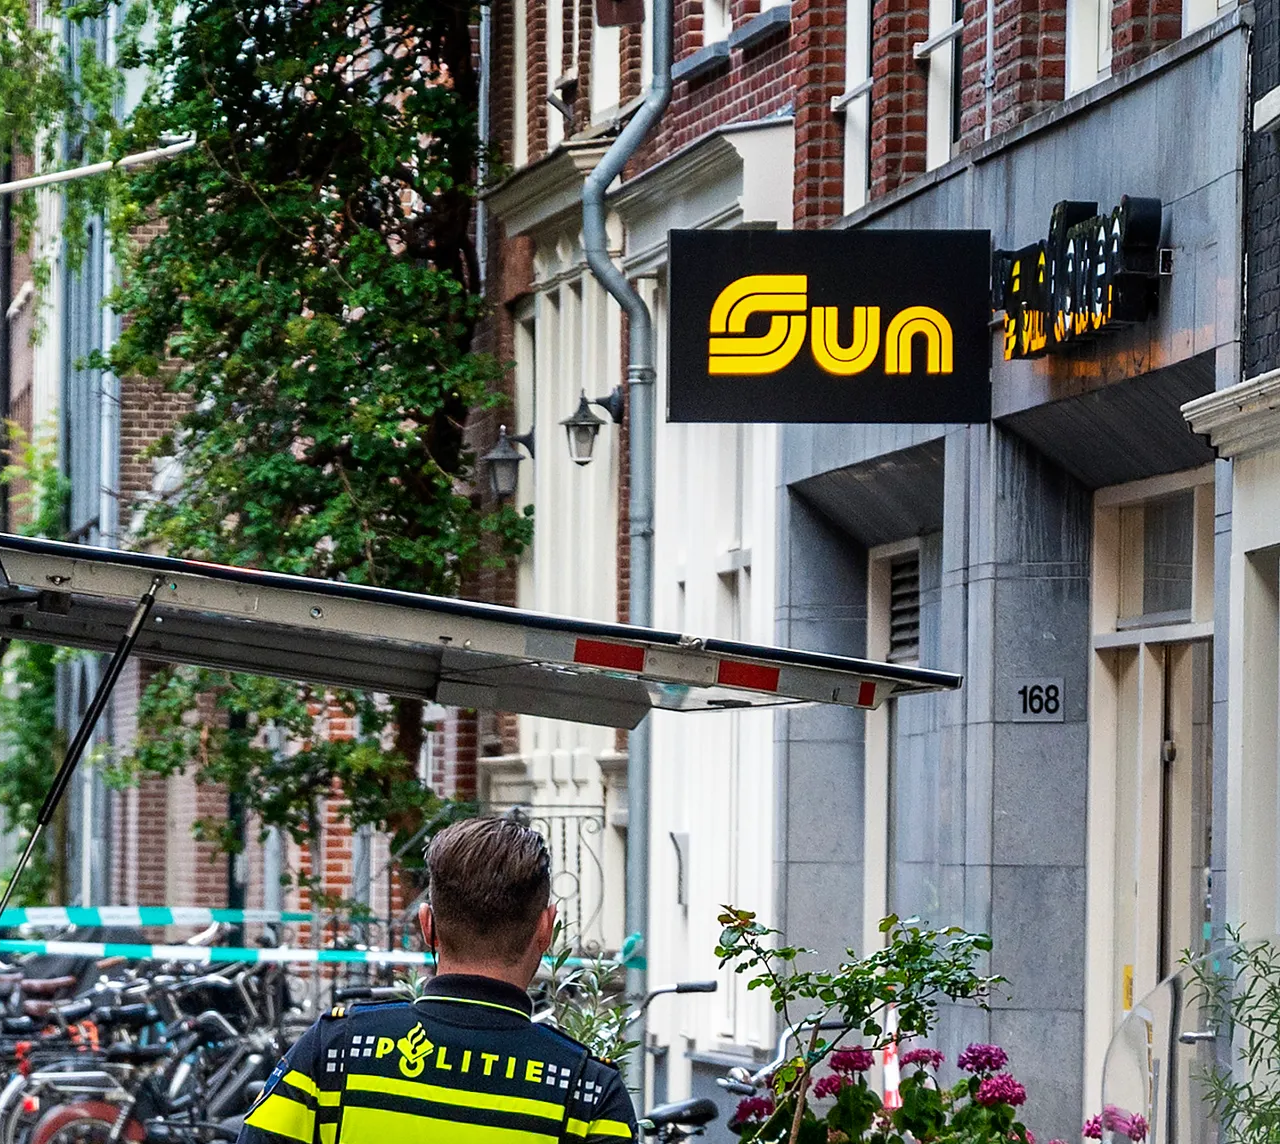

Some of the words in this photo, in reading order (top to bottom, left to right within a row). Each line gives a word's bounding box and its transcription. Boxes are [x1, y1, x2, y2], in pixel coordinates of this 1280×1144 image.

[708, 274, 954, 376] Sun
[1017, 684, 1060, 715] 168
[375, 1022, 543, 1083] POLITIE
